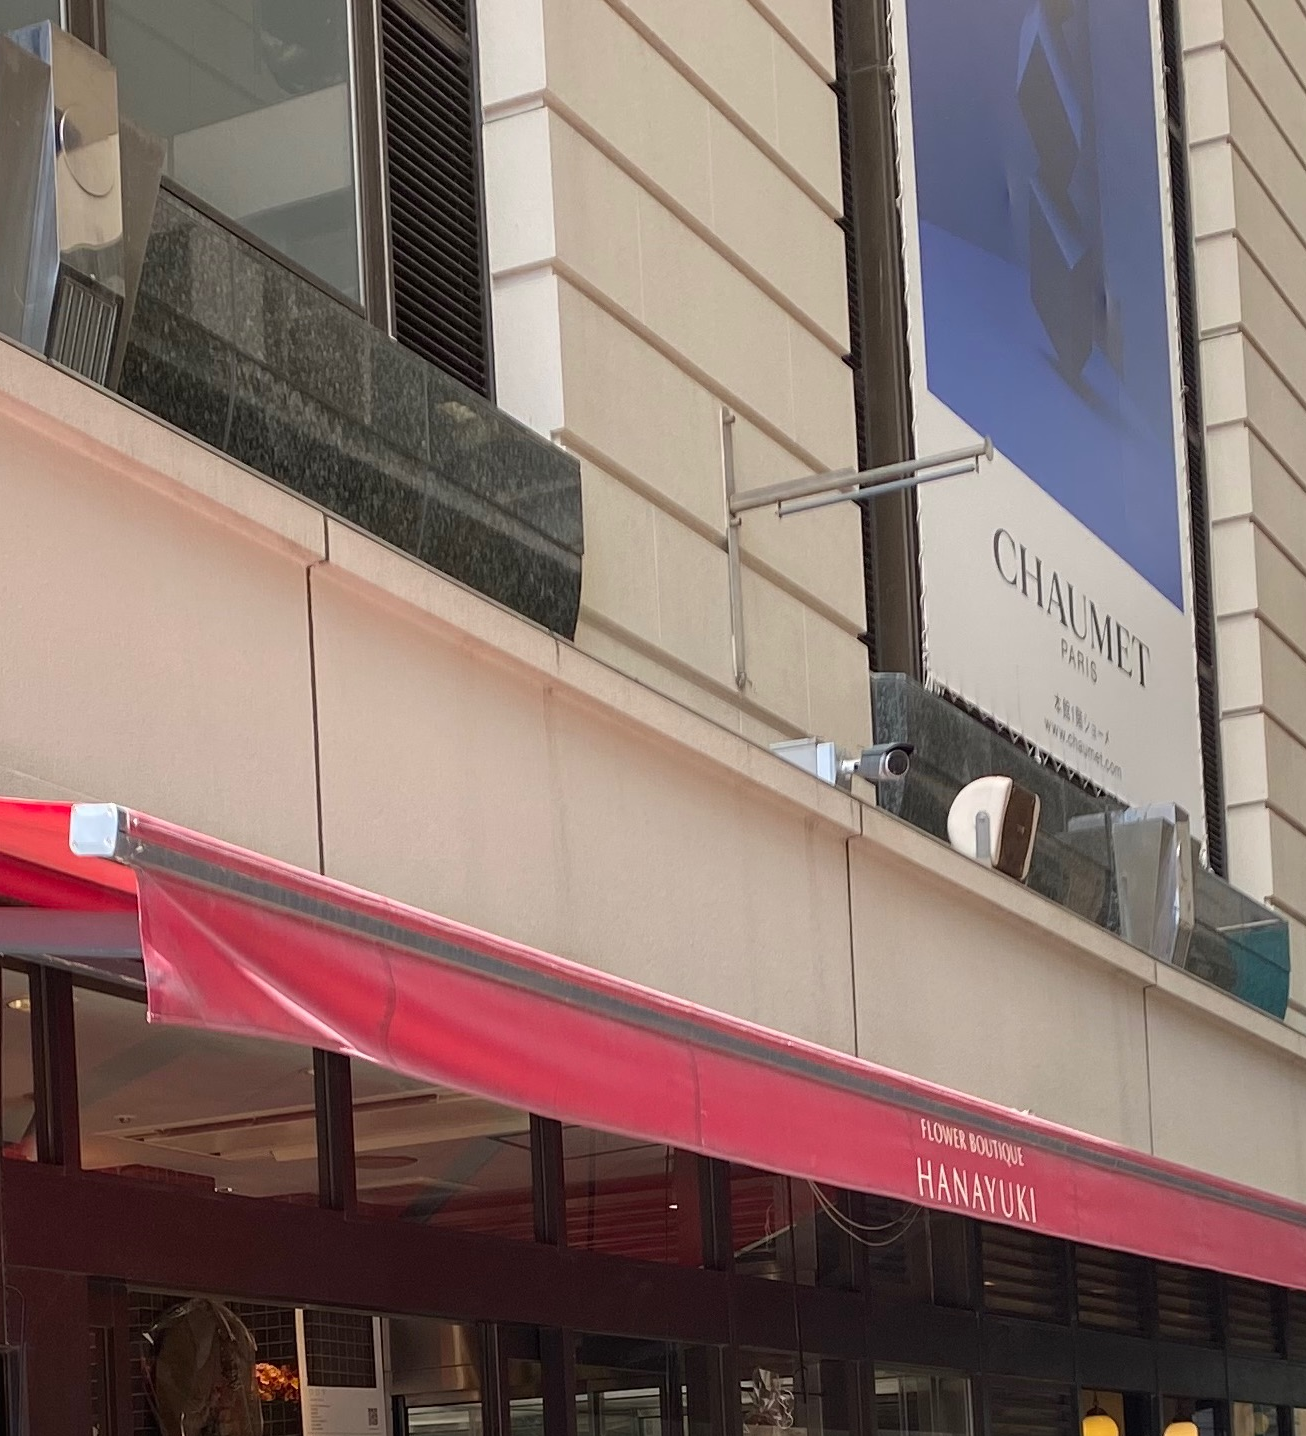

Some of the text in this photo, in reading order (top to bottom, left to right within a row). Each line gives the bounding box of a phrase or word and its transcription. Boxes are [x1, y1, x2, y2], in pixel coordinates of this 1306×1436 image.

[993, 527, 1151, 689] CHAUMET
[1060, 637, 1098, 685] PARIS
[920, 1118, 1025, 1168] FLOWER BOUTIQUE
[916, 1156, 1038, 1224] HANAYUKI
